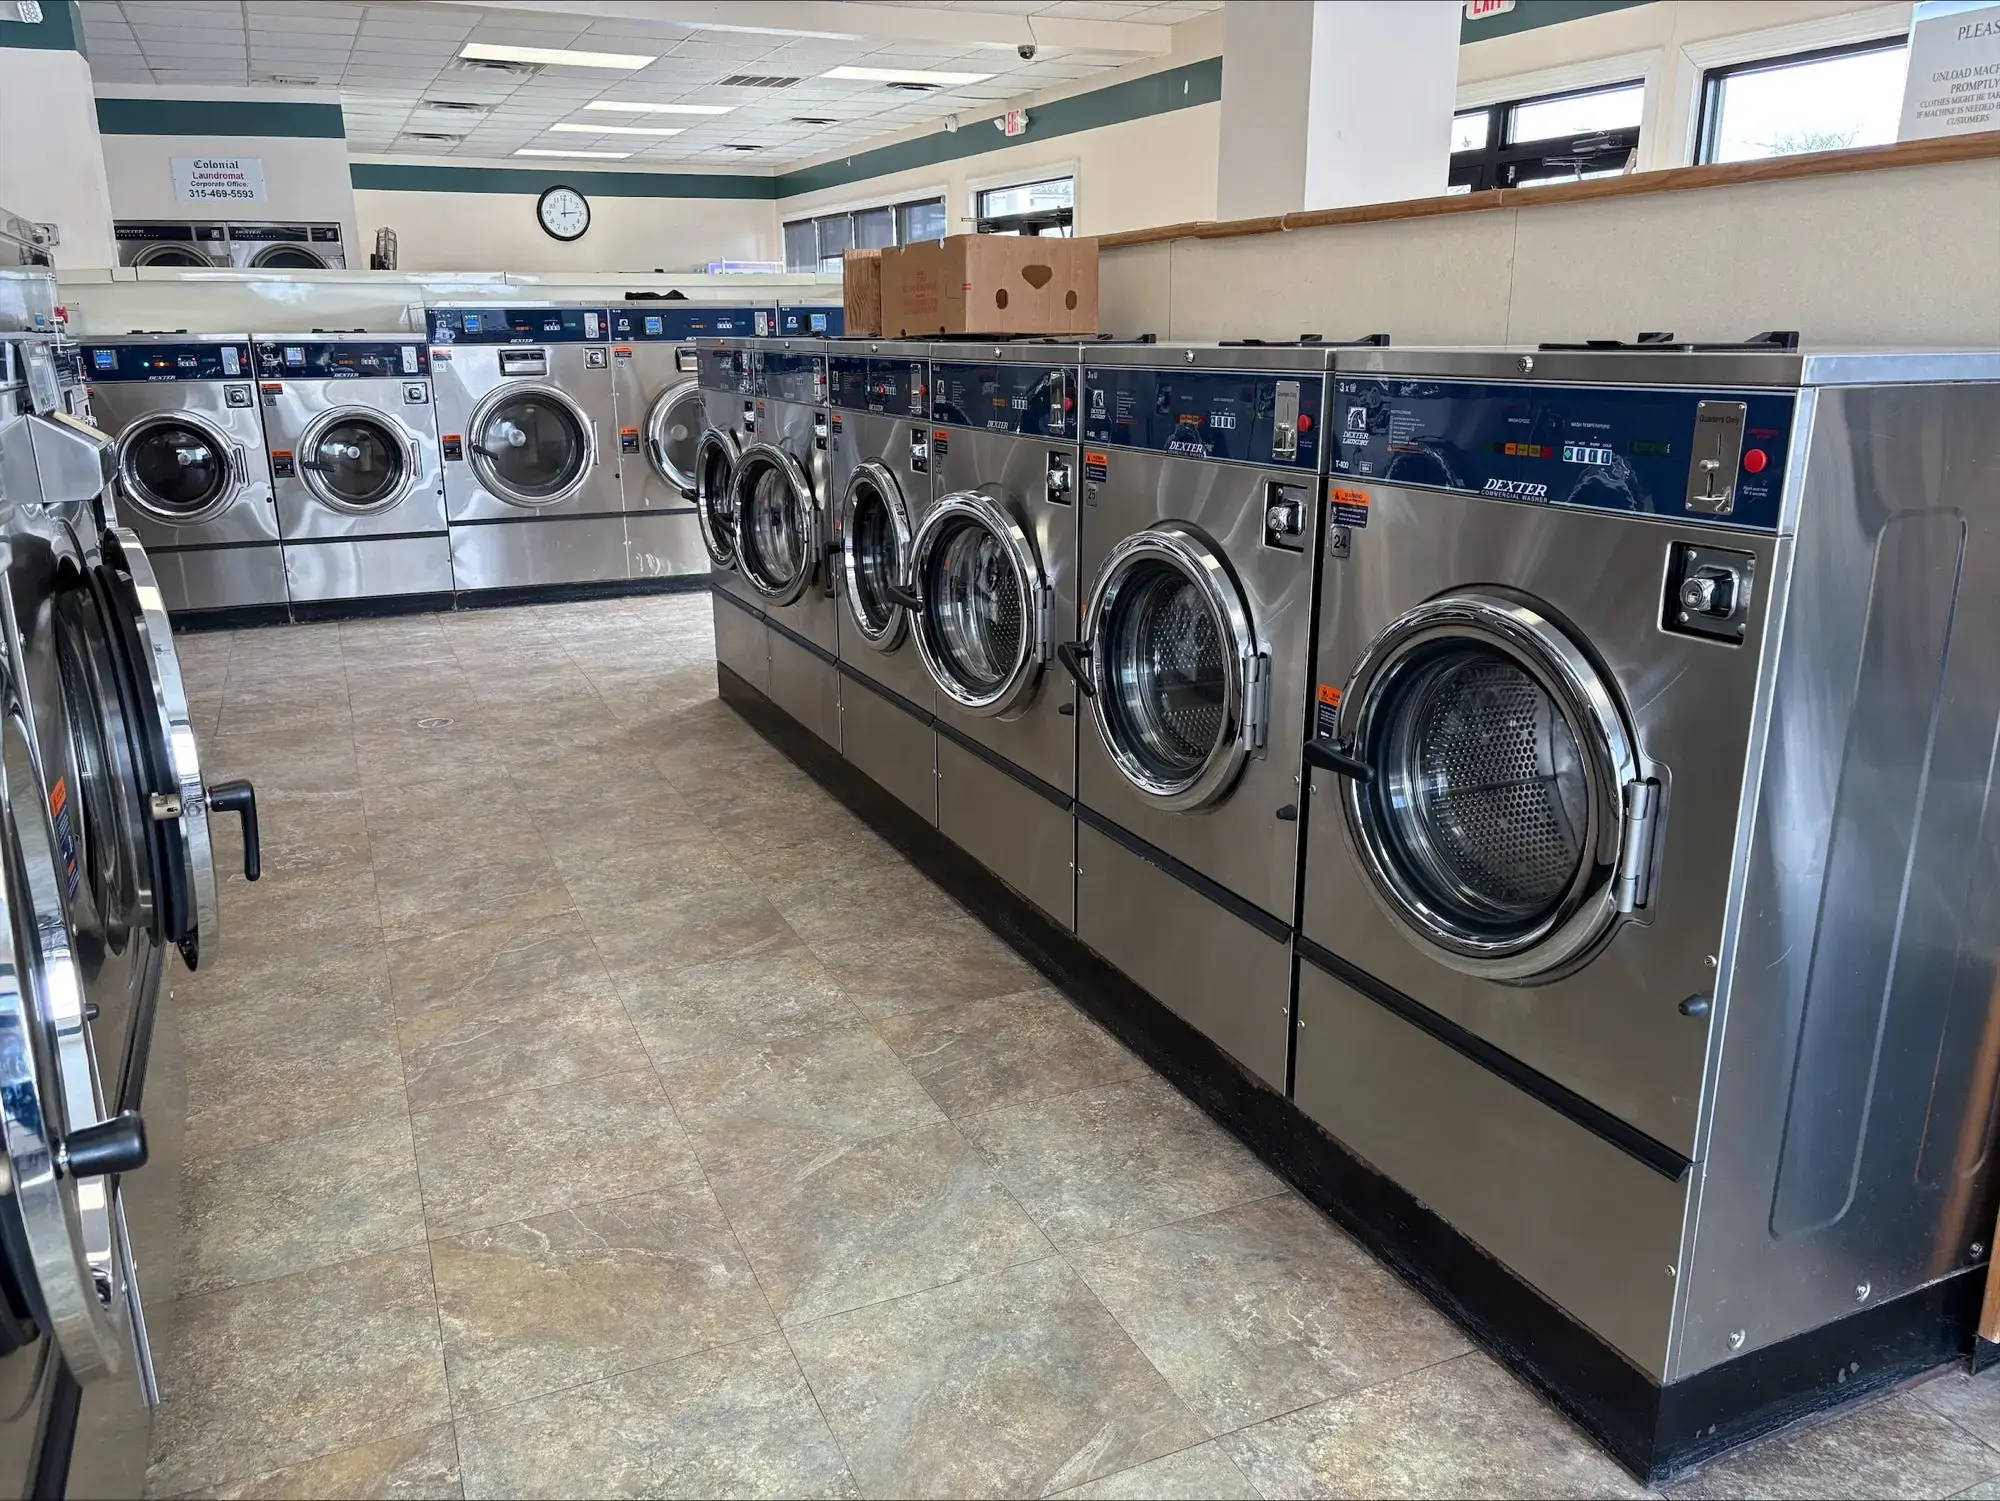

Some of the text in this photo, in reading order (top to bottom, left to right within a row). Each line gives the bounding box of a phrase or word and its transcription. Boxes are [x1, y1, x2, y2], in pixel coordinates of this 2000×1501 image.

[1932, 67, 1972, 82] UNLOAD
[1950, 78, 2000, 94] PROMPTLY
[1920, 97, 1951, 109] CLOTHES
[1951, 95, 1976, 105] MIGHT
[1977, 93, 1986, 101] BE
[1917, 111, 1924, 119] IF
[1923, 107, 1955, 118] MACHINE
[1957, 105, 1964, 114] IS
[1965, 103, 1995, 113] NEEDED
[1946, 114, 1990, 126] CUSTOMERS
[193, 159, 239, 169] Colonial
[192, 171, 244, 180] Laundromat
[190, 180, 249, 188] Corporate Office:
[188, 189, 254, 198] 315-469-5593
[986, 420, 1009, 430] DEXTER
[1700, 414, 1740, 425] Quarters Only
[1342, 431, 1369, 440] DEXTER
[1169, 440, 1203, 453] DEXTER
[1335, 460, 1349, 469] T-400
[1483, 478, 1548, 497] DEXTER
[1087, 488, 1097, 500] 25
[1480, 489, 1548, 504] COMMERCIAL WASHER
[1333, 534, 1348, 549] 24
